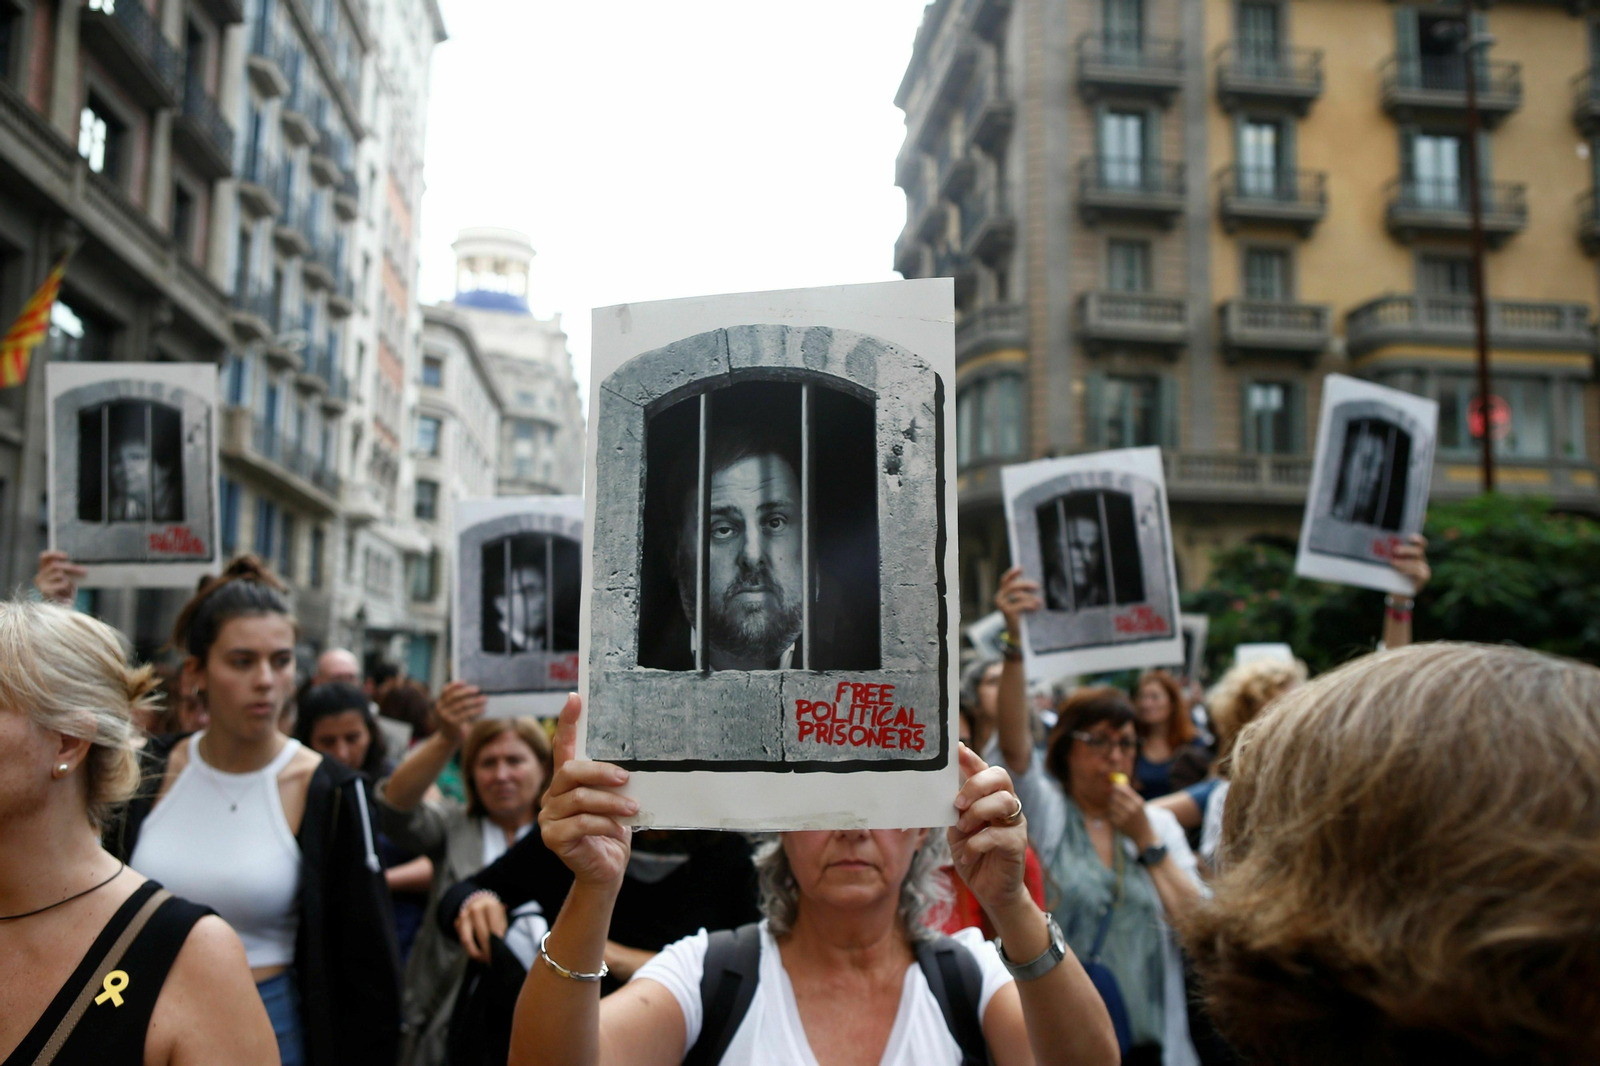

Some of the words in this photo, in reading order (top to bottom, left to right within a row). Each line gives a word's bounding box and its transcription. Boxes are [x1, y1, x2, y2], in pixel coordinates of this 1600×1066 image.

[835, 682, 895, 706] FREE
[795, 699, 926, 728] POLITICAL
[797, 721, 925, 752] PRISONERS
